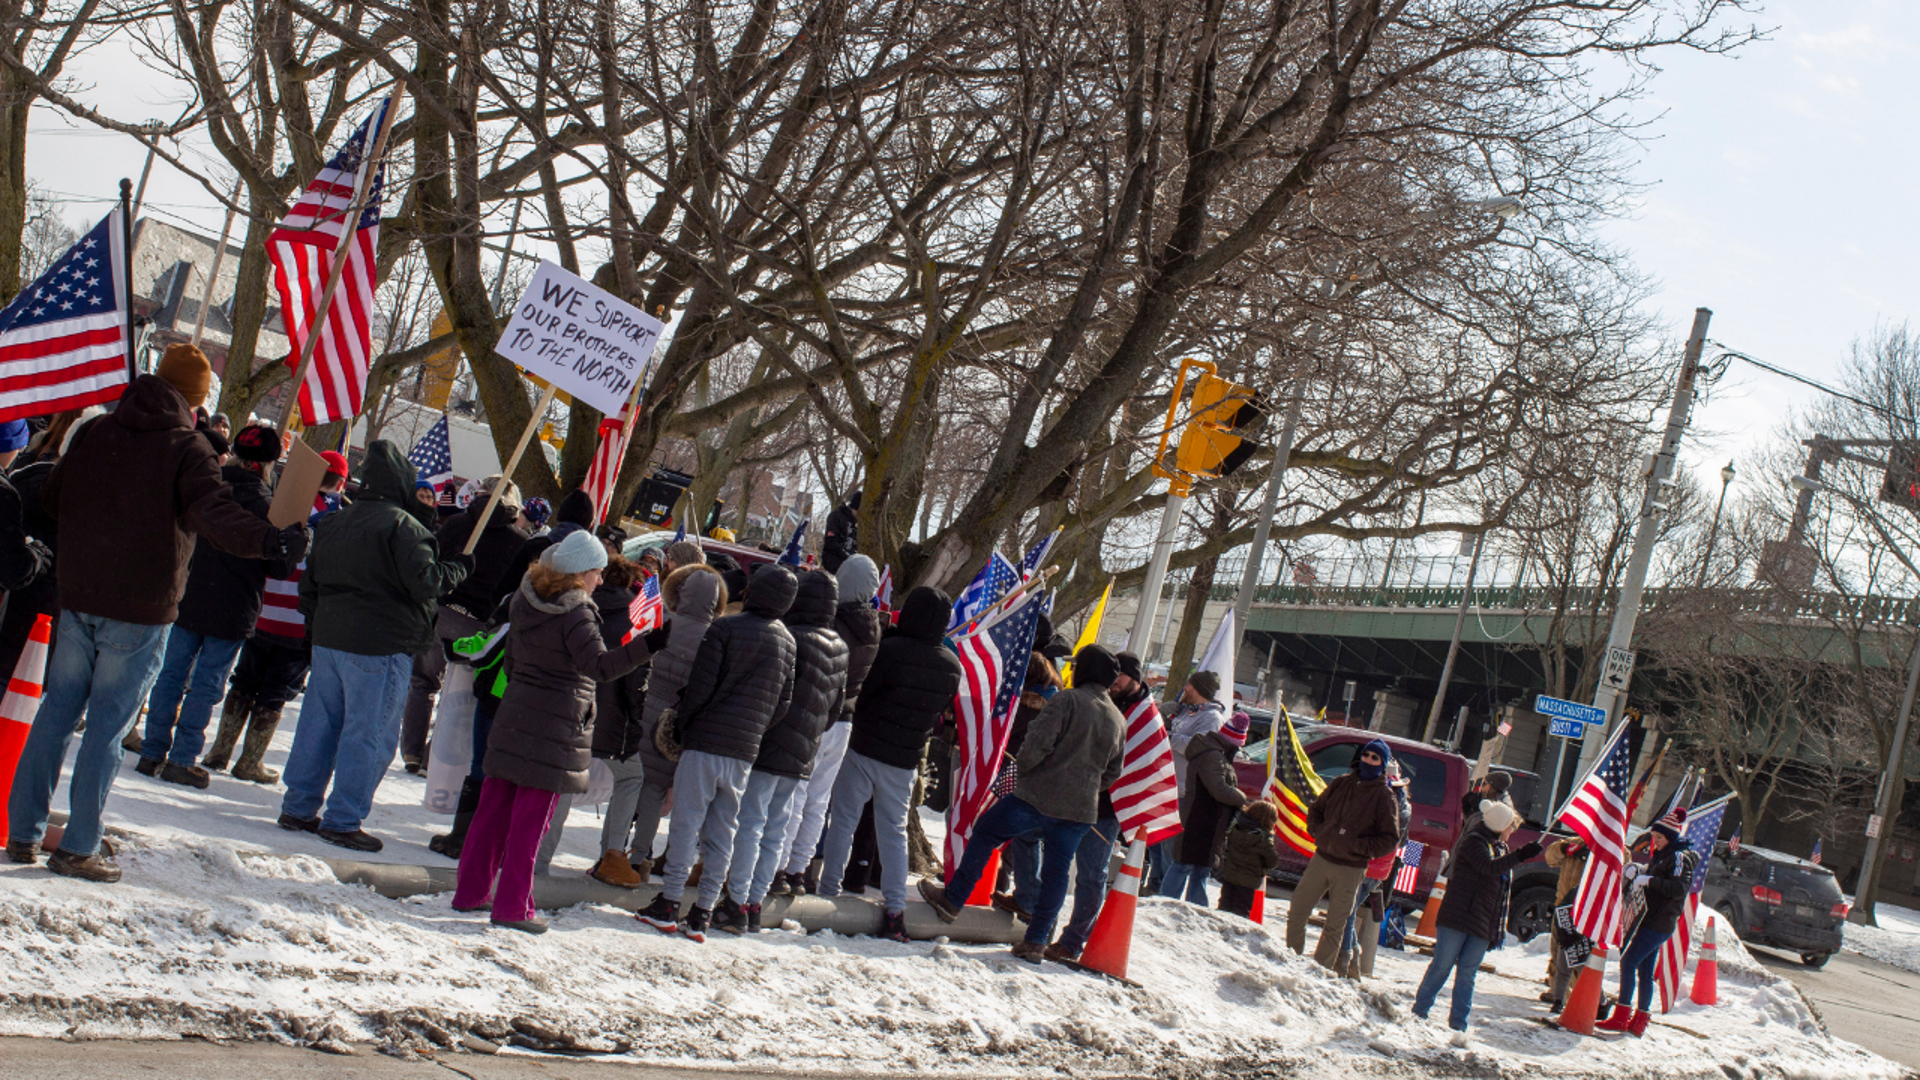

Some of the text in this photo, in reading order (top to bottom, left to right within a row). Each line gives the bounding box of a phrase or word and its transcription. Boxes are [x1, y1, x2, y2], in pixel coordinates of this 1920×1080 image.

[541, 278, 656, 347] WE SUPPORT
[521, 303, 638, 370] OUR BROTHERS
[509, 327, 631, 396] TO THE NORTH
[651, 502, 669, 516] CAT
[1609, 662, 1631, 675] WAY
[1611, 650, 1633, 664] ONE
[1538, 698, 1597, 721] MASSACHUSETTS
